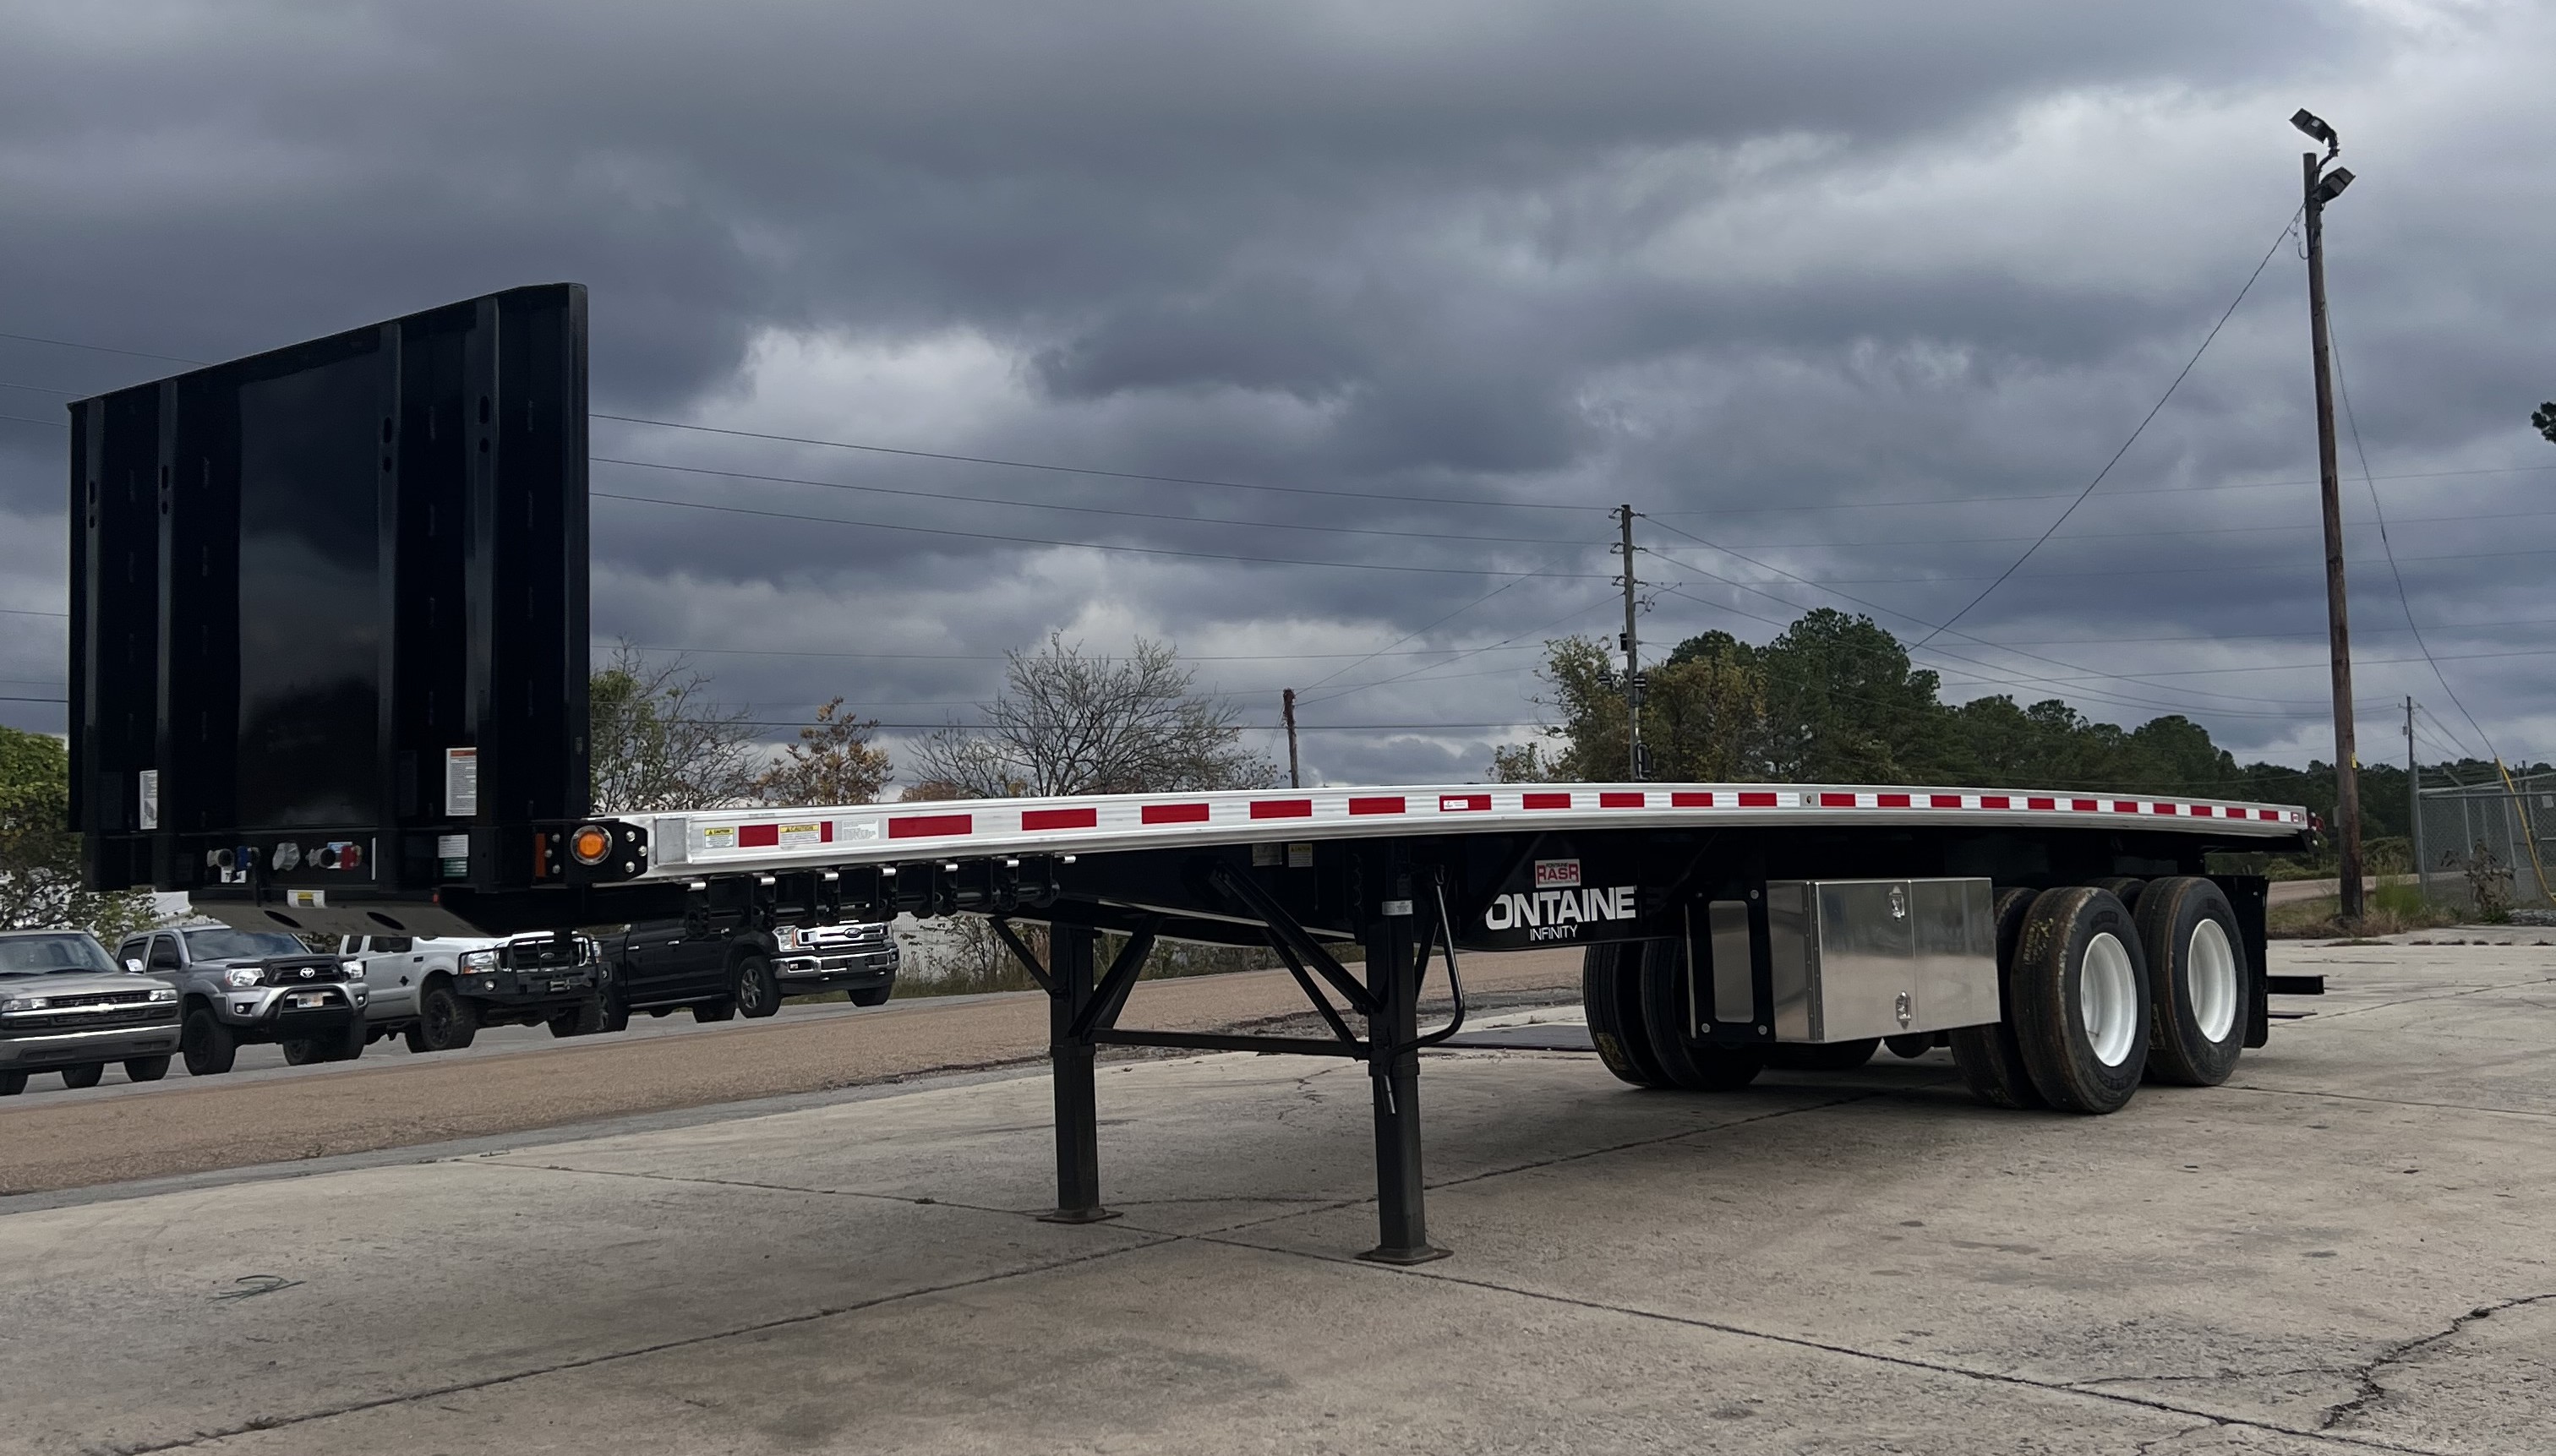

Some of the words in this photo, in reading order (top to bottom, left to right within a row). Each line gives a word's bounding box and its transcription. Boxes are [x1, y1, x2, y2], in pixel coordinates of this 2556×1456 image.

[1537, 864, 1580, 885] RASR
[1485, 886, 1636, 930] ONTAINE
[1530, 924, 1578, 941] INFINITY
